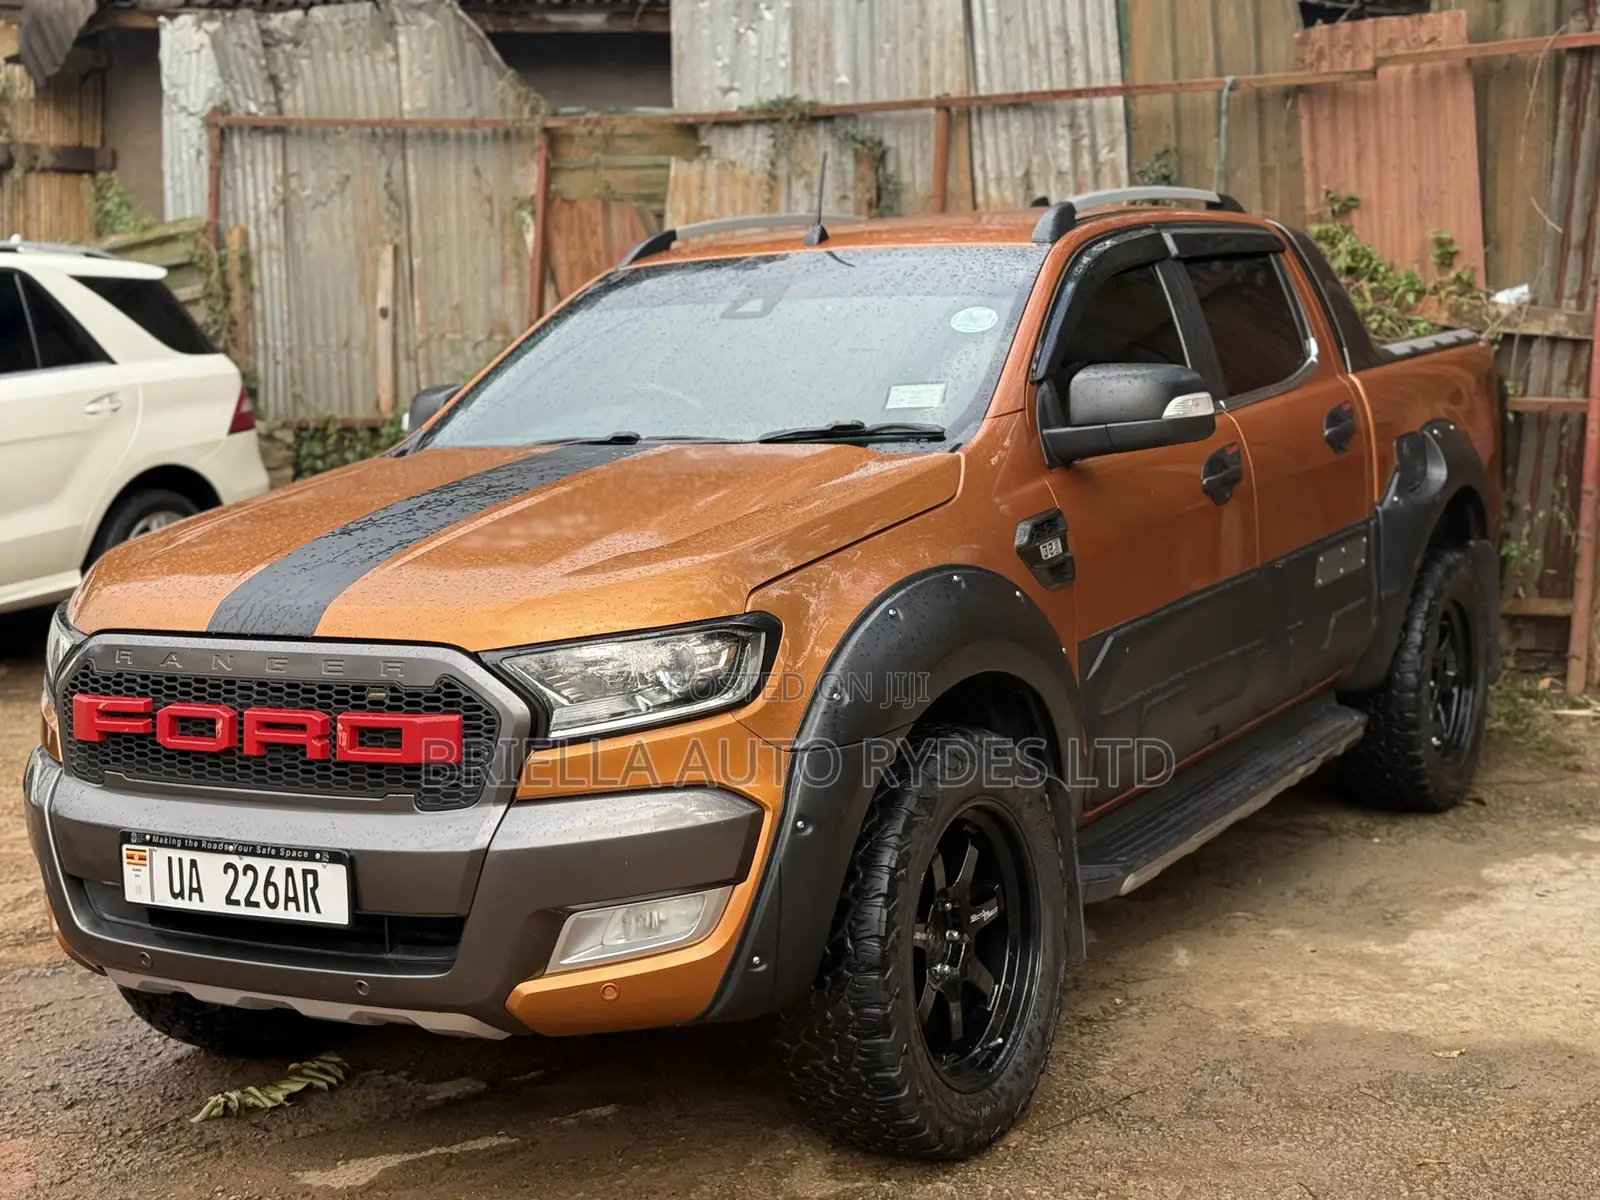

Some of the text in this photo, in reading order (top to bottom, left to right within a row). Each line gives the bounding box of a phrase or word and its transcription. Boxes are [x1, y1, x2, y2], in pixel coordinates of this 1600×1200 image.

[114, 648, 406, 677] RANGER
[72, 693, 463, 764] FORD
[152, 834, 182, 848] Making
[184, 837, 199, 848] the
[232, 843, 253, 853] Your
[256, 845, 276, 855] Safe
[279, 847, 309, 859] Space
[167, 855, 322, 914] UA 226AR
